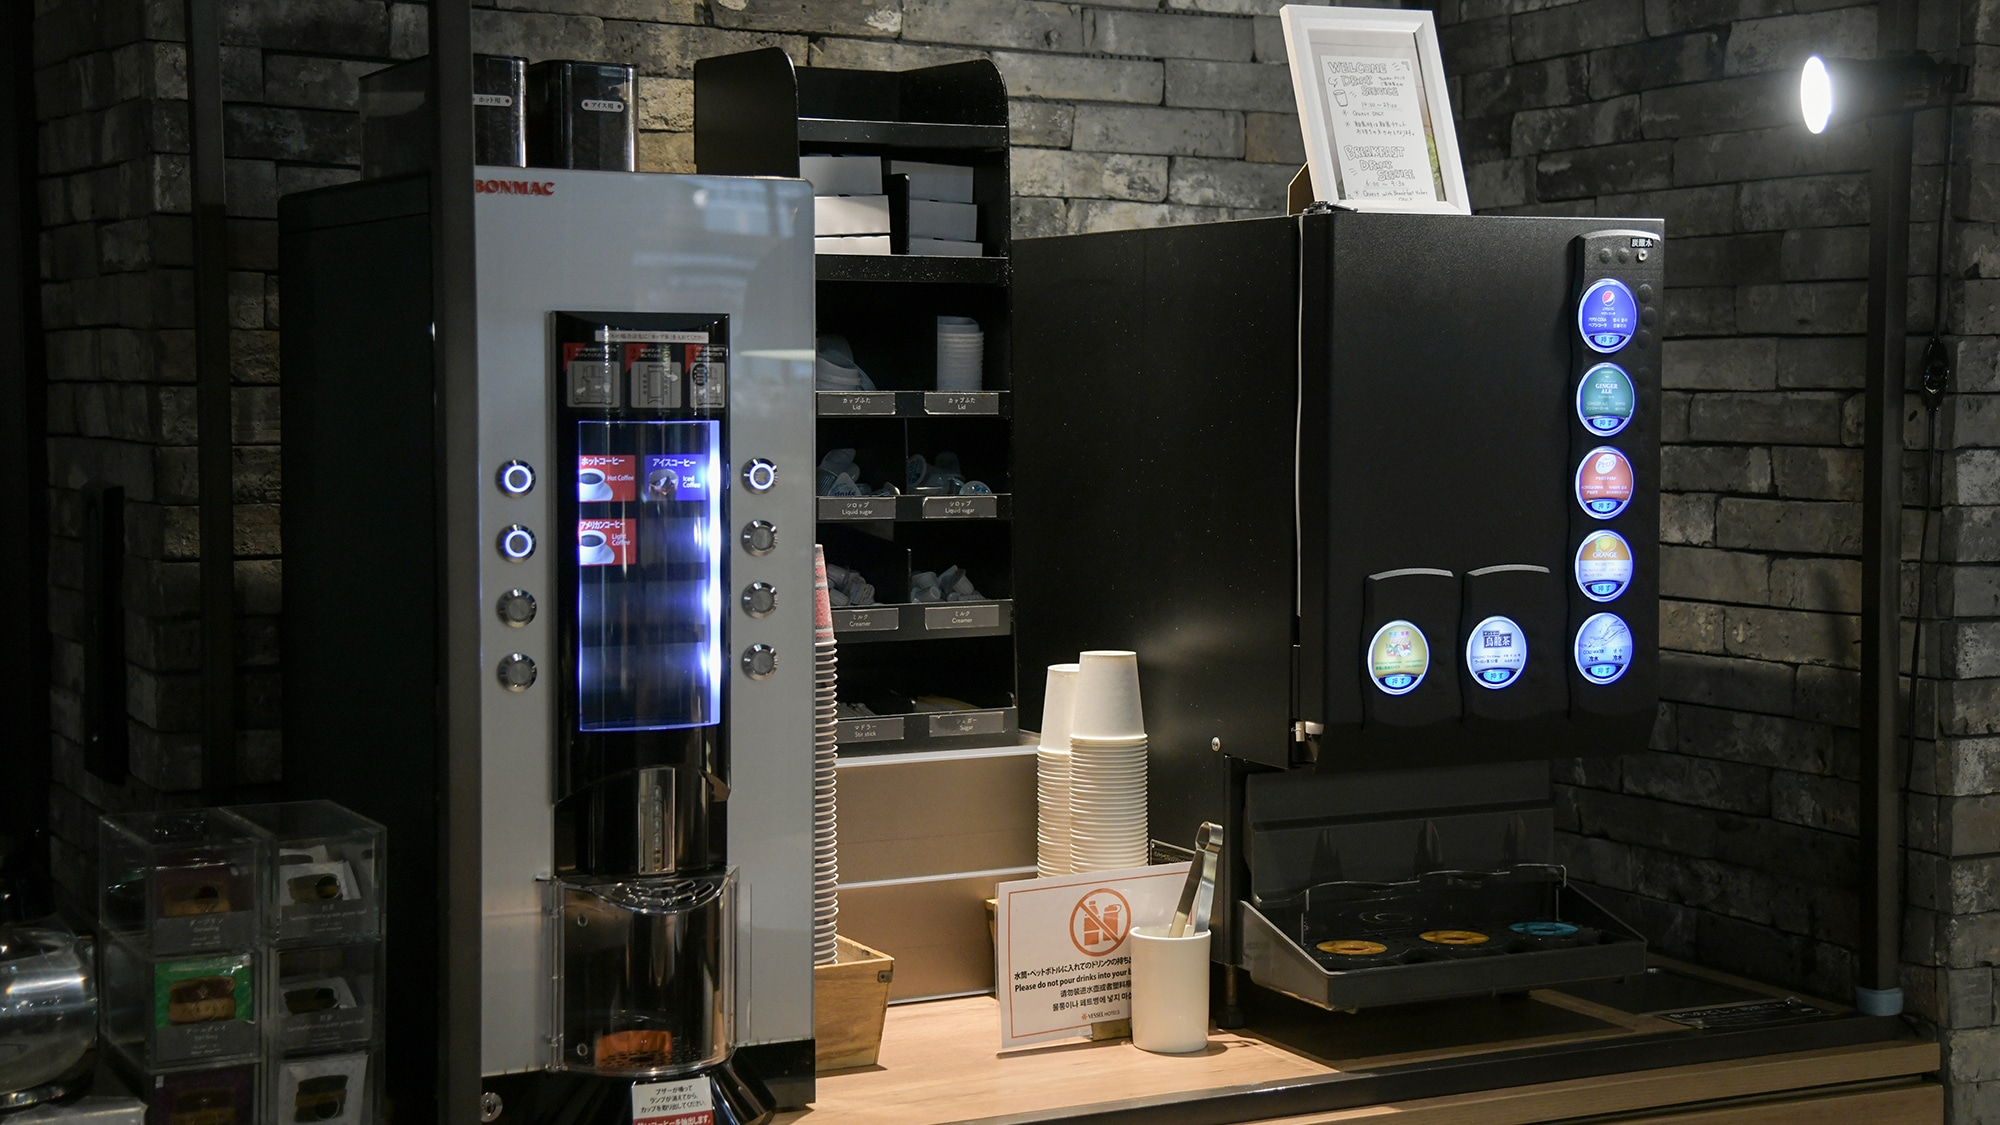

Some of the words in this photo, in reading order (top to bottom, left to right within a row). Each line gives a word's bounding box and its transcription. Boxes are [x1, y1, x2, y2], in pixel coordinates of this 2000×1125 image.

[1328, 62, 1387, 74] WELCOME
[1344, 145, 1405, 161] BREAKFAST
[475, 180, 555, 196] BONMAC
[582, 457, 625, 466] ホットコーヒー
[653, 458, 696, 467] アイスコーヒー
[580, 521, 625, 530] アメリカンコーヒー
[1015, 983, 1036, 992] Please
[1060, 979, 1075, 987] pour
[1076, 974, 1096, 983] drinks
[1112, 970, 1127, 980] your
